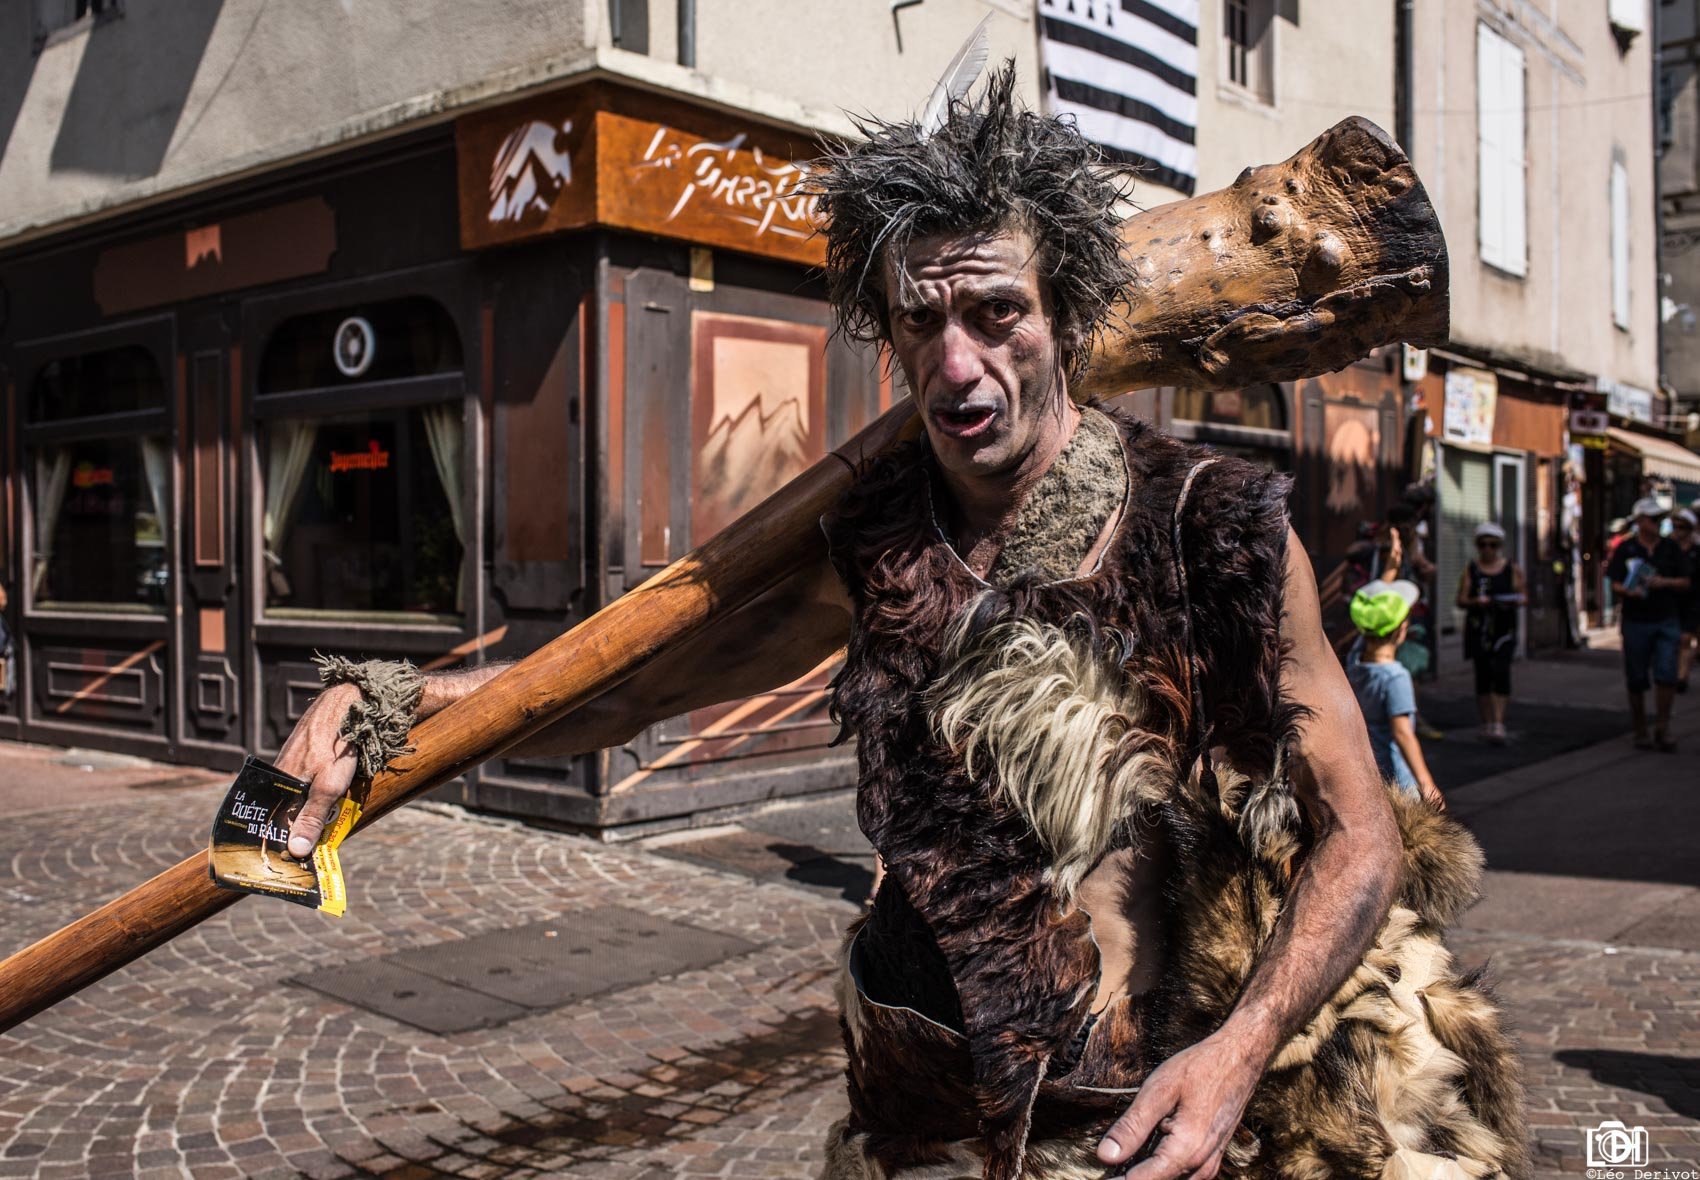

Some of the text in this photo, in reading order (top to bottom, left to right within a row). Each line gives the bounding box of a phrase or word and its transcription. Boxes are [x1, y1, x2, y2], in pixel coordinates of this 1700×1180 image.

[234, 790, 246, 802] LA
[231, 800, 269, 822] QUÊTE
[258, 819, 288, 844] RÂLE
[328, 830, 338, 843] DES
[336, 807, 352, 830] JUSTES
